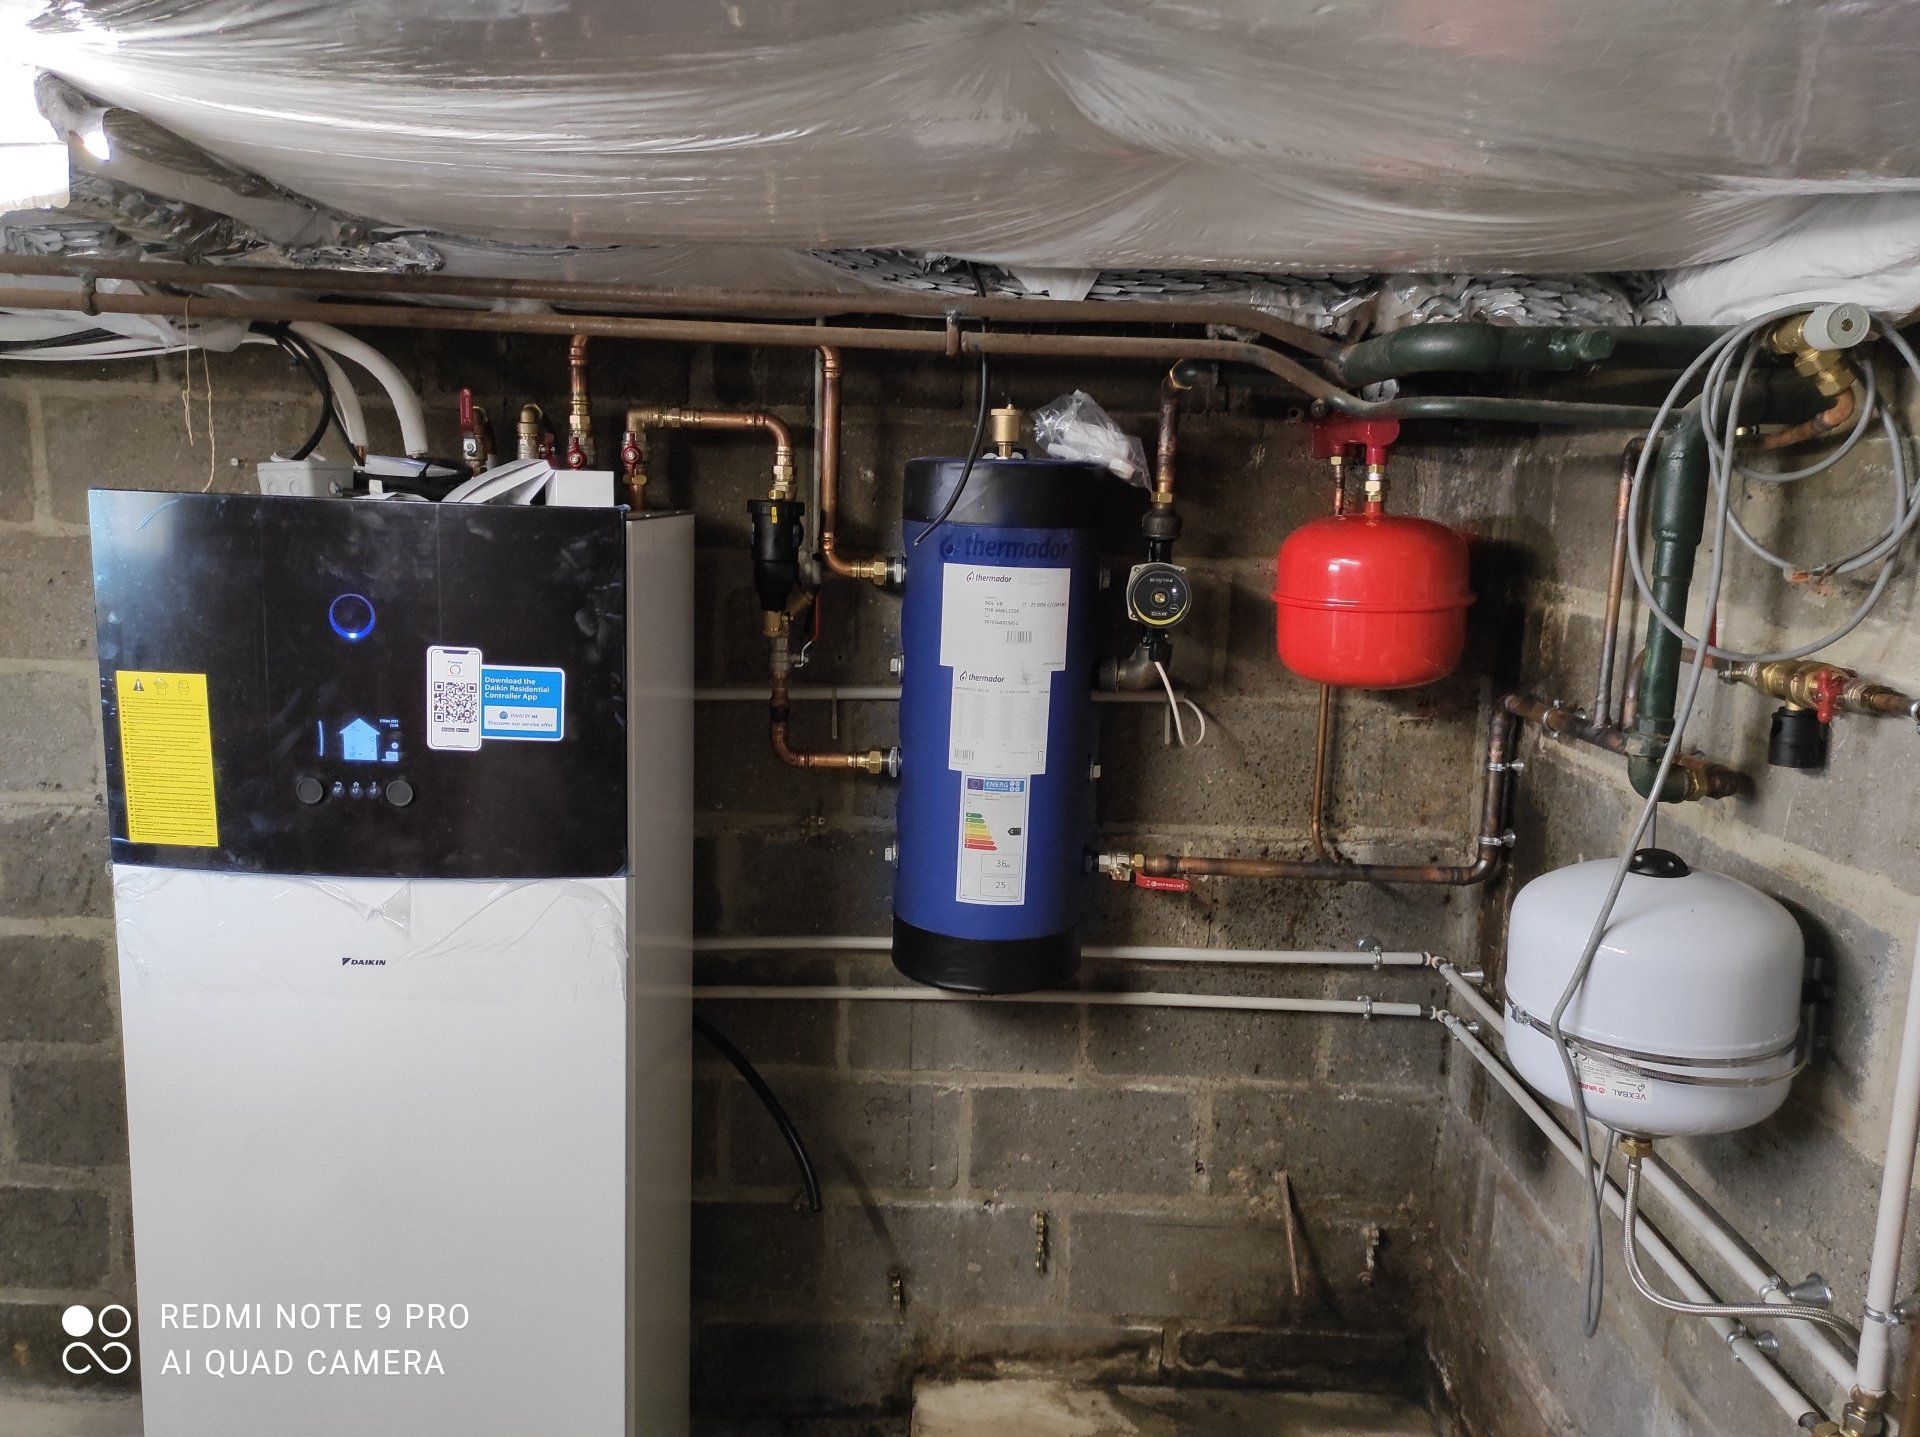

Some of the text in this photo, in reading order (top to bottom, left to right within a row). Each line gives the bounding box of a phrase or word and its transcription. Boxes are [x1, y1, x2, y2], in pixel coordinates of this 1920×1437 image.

[965, 532, 1068, 559] thermador
[975, 573, 1012, 583] thermador
[968, 673, 1005, 683] thermador
[484, 684, 550, 693] Daikin Residential
[995, 881, 1006, 889] 25
[1612, 1088, 1646, 1100] VEXBAL
